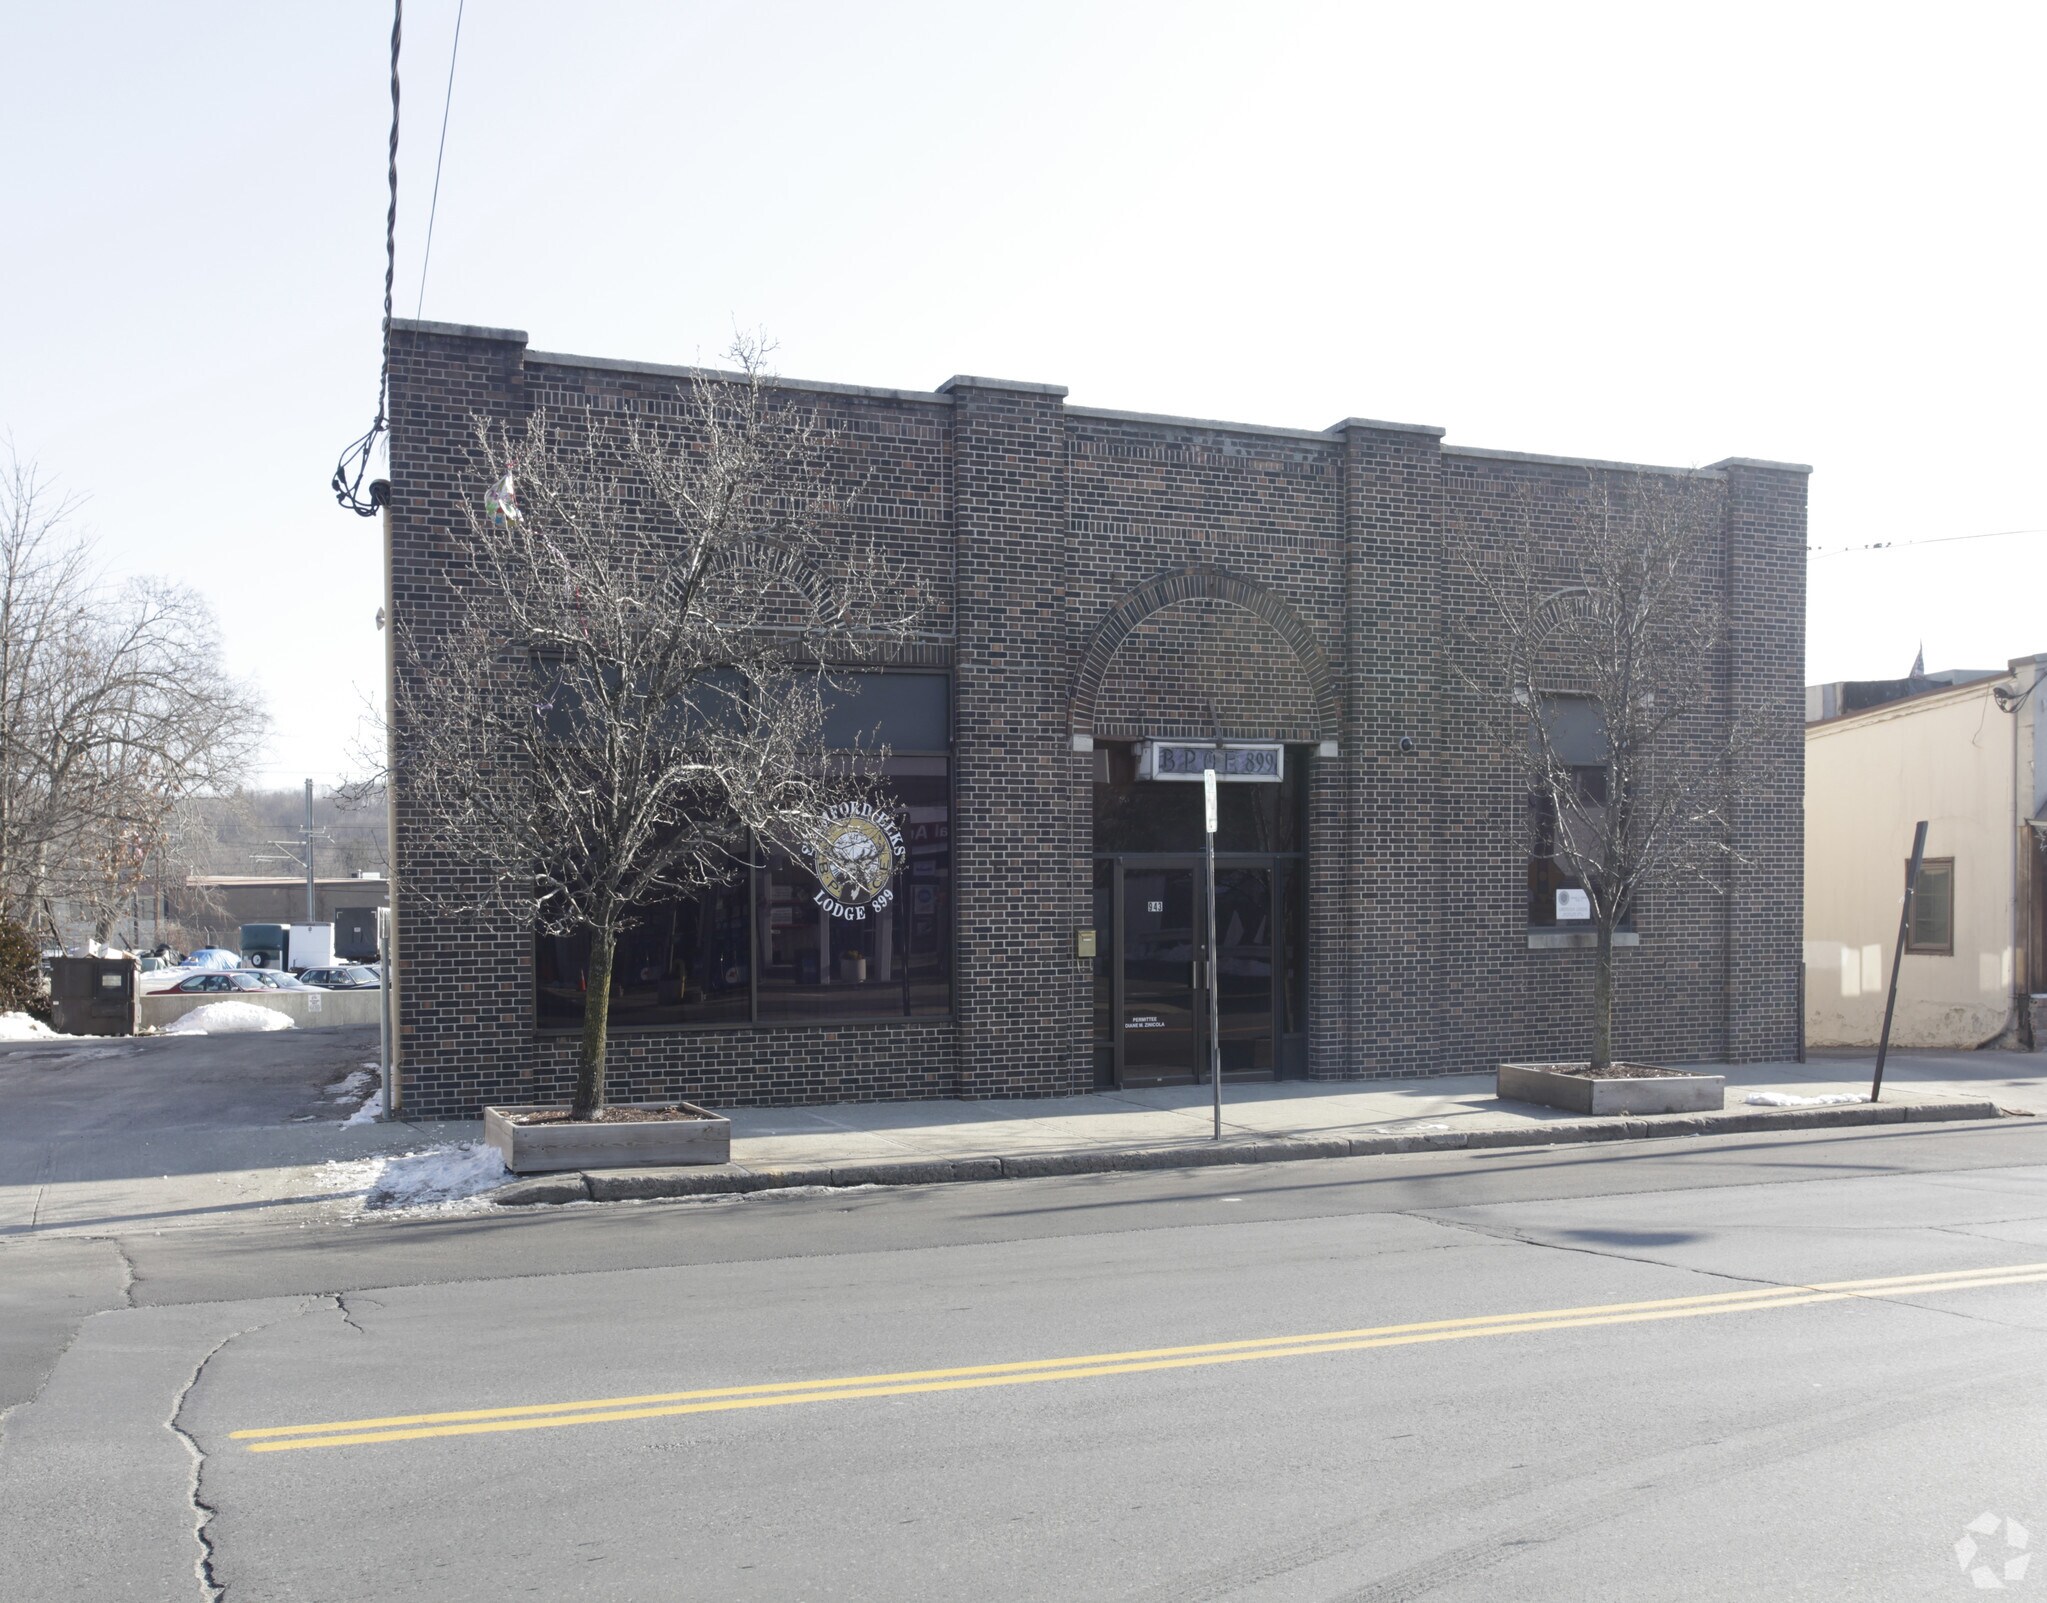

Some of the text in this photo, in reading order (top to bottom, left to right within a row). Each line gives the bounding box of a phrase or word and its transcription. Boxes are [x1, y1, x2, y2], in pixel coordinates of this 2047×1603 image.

[1245, 751, 1274, 773] 899
[876, 811, 906, 856] ELKS
[813, 890, 866, 920] LODGE
[871, 888, 895, 913] 899
[1148, 902, 1162, 912] 943
